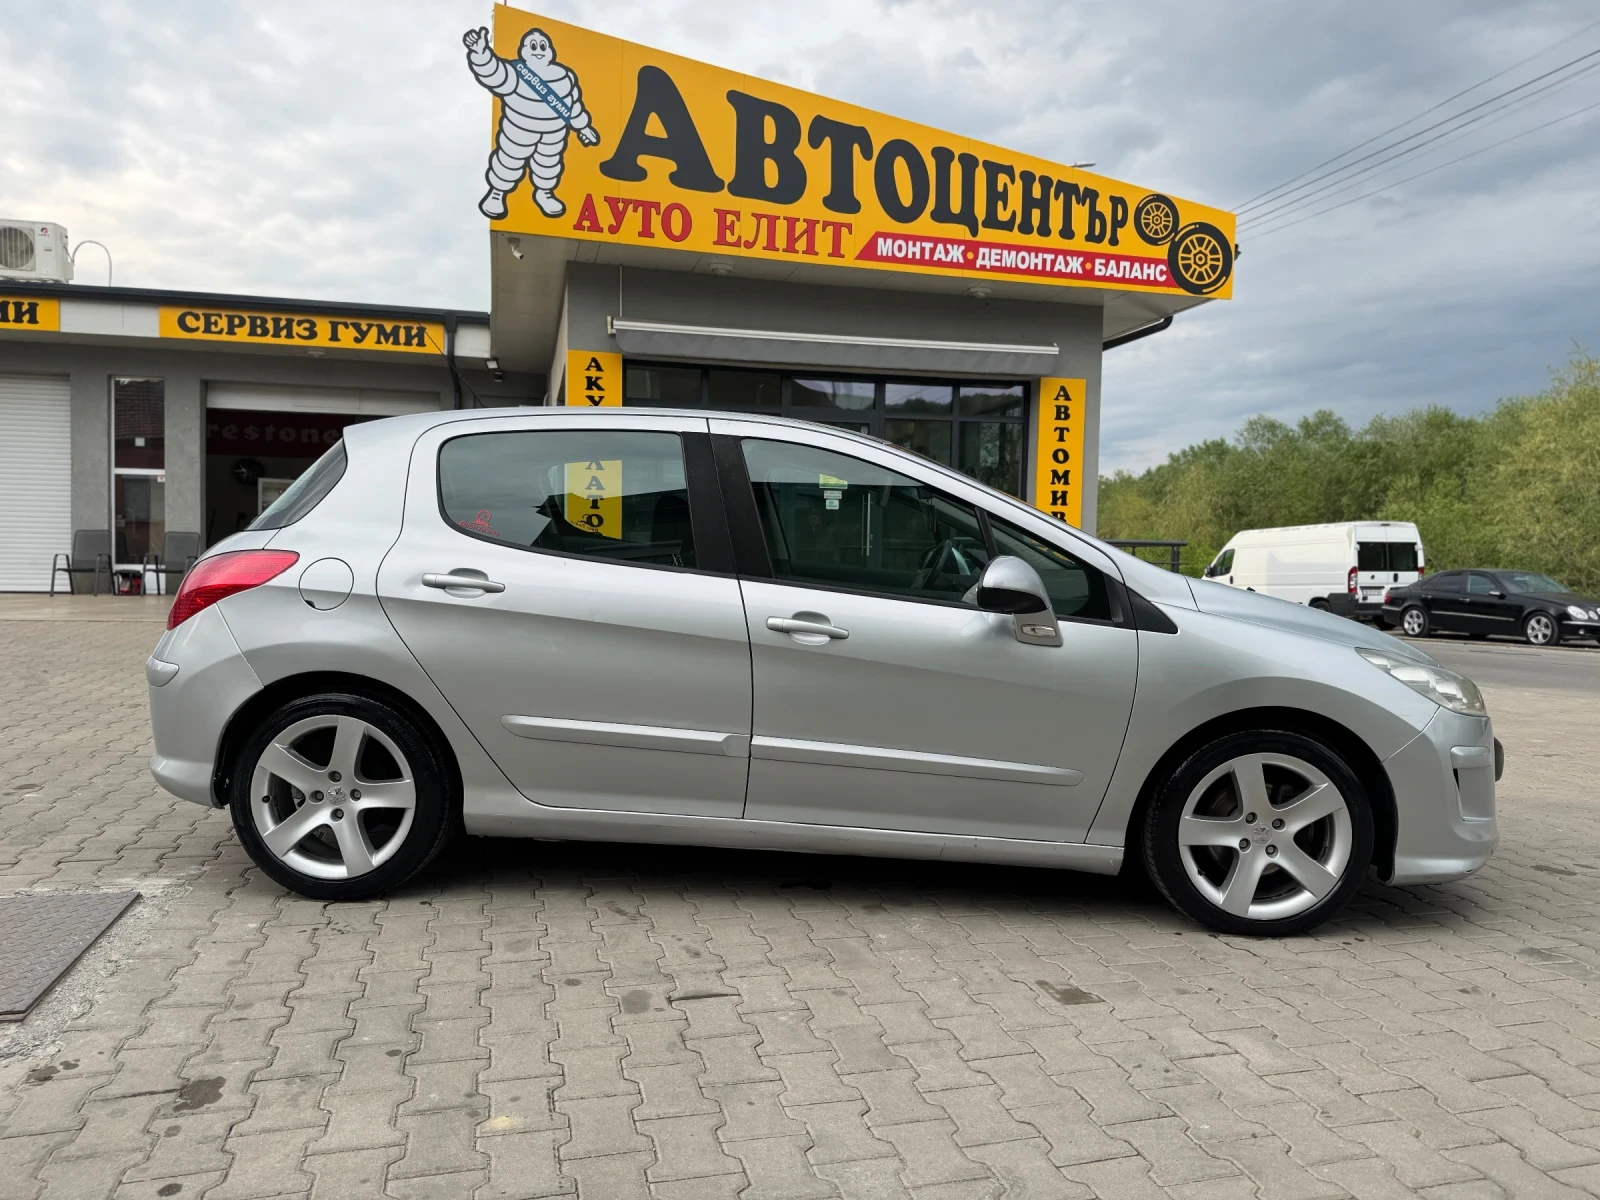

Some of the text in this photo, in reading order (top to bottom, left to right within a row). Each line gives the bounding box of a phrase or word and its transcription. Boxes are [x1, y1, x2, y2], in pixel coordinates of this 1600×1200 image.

[516, 63, 571, 118] сервиз гуми
[599, 65, 1129, 247] АВТОЦЕНТЪР
[573, 193, 853, 259] АУТО ЕЛИТ
[876, 237, 1168, 282] МОНТАЖ ДЕМОНТАЖ БАЛАНС
[177, 311, 427, 348] СЕРВИЗ ГУМИ
